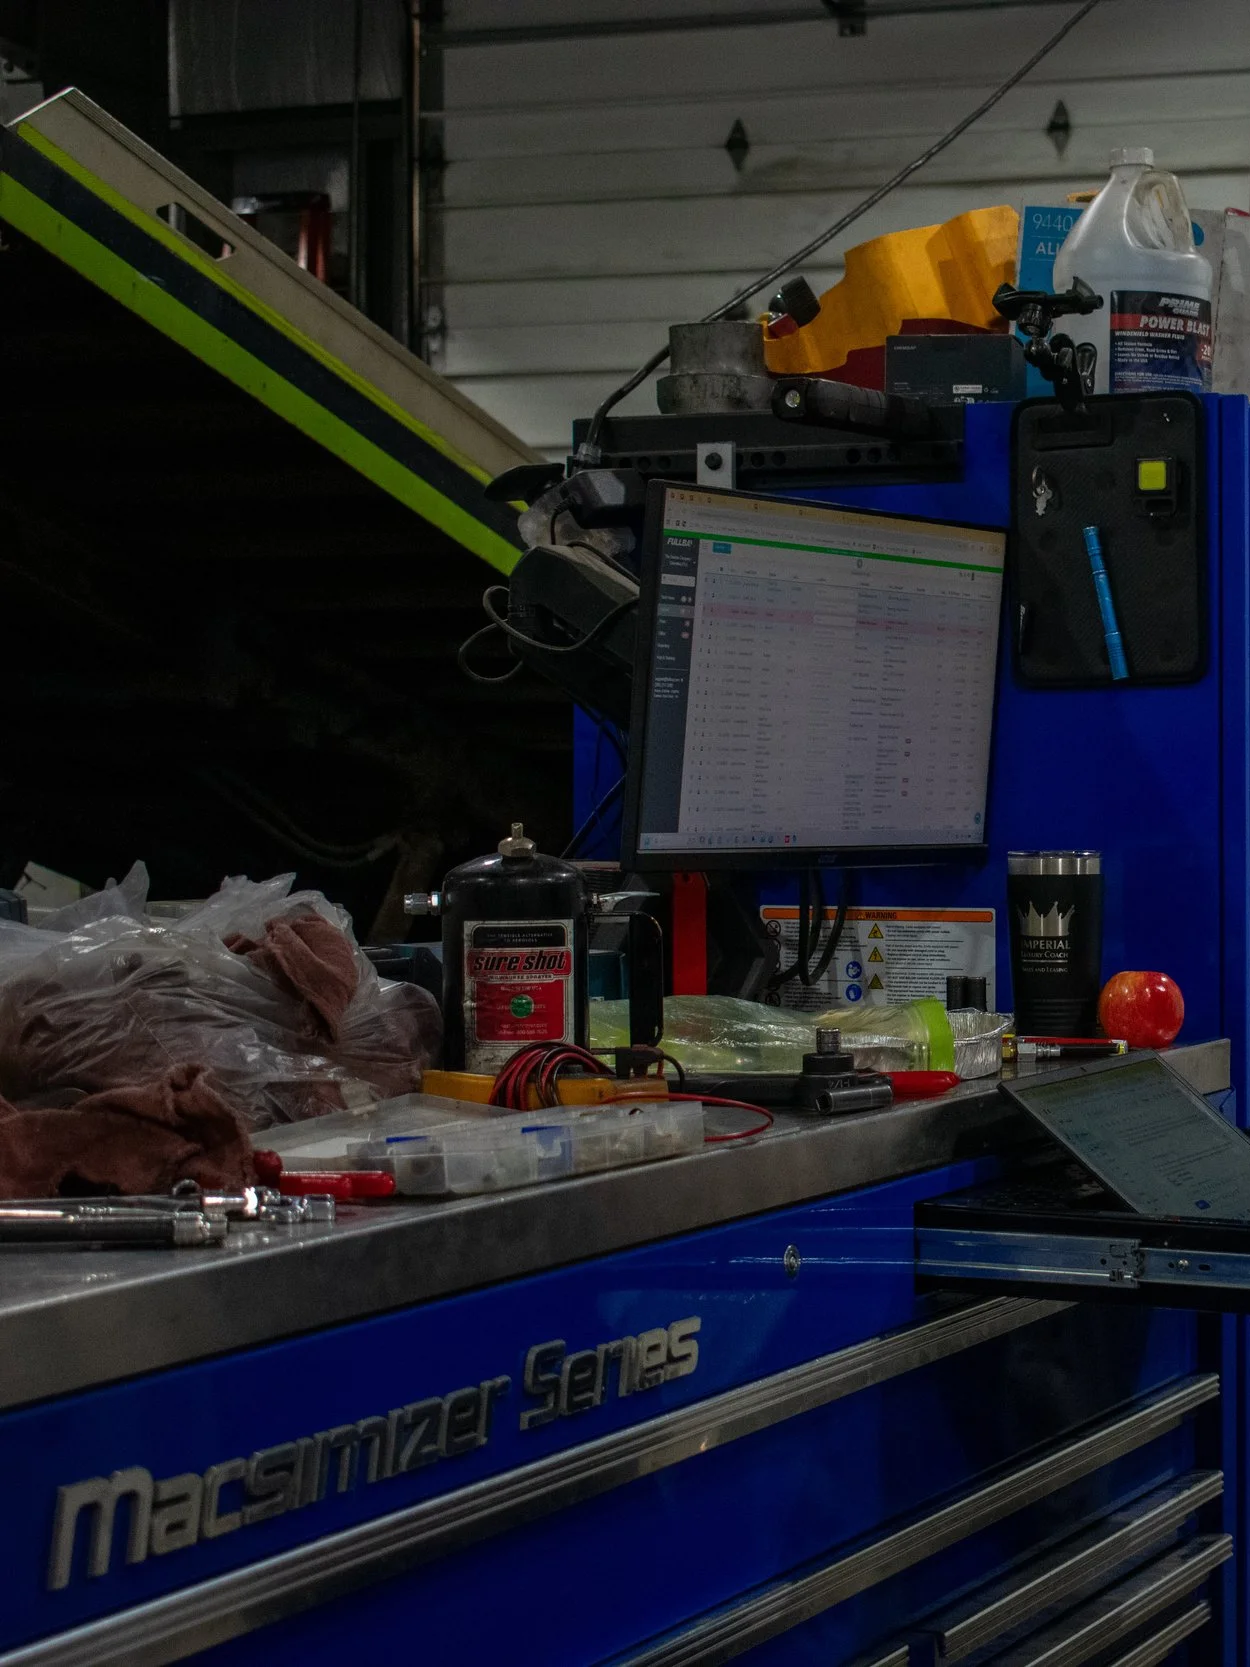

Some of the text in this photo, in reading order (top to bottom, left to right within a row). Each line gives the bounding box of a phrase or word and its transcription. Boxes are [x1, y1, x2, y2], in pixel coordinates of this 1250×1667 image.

[1032, 213, 1073, 232] 9440
[1158, 297, 1200, 309] PRIME
[1140, 315, 1210, 337] POWER BLAST
[1149, 332, 1171, 340] WASHER
[865, 911, 897, 920] WARNING
[1021, 940, 1071, 950] IMPERIAL
[473, 950, 567, 971] sure shot
[519, 1315, 702, 1431] Series
